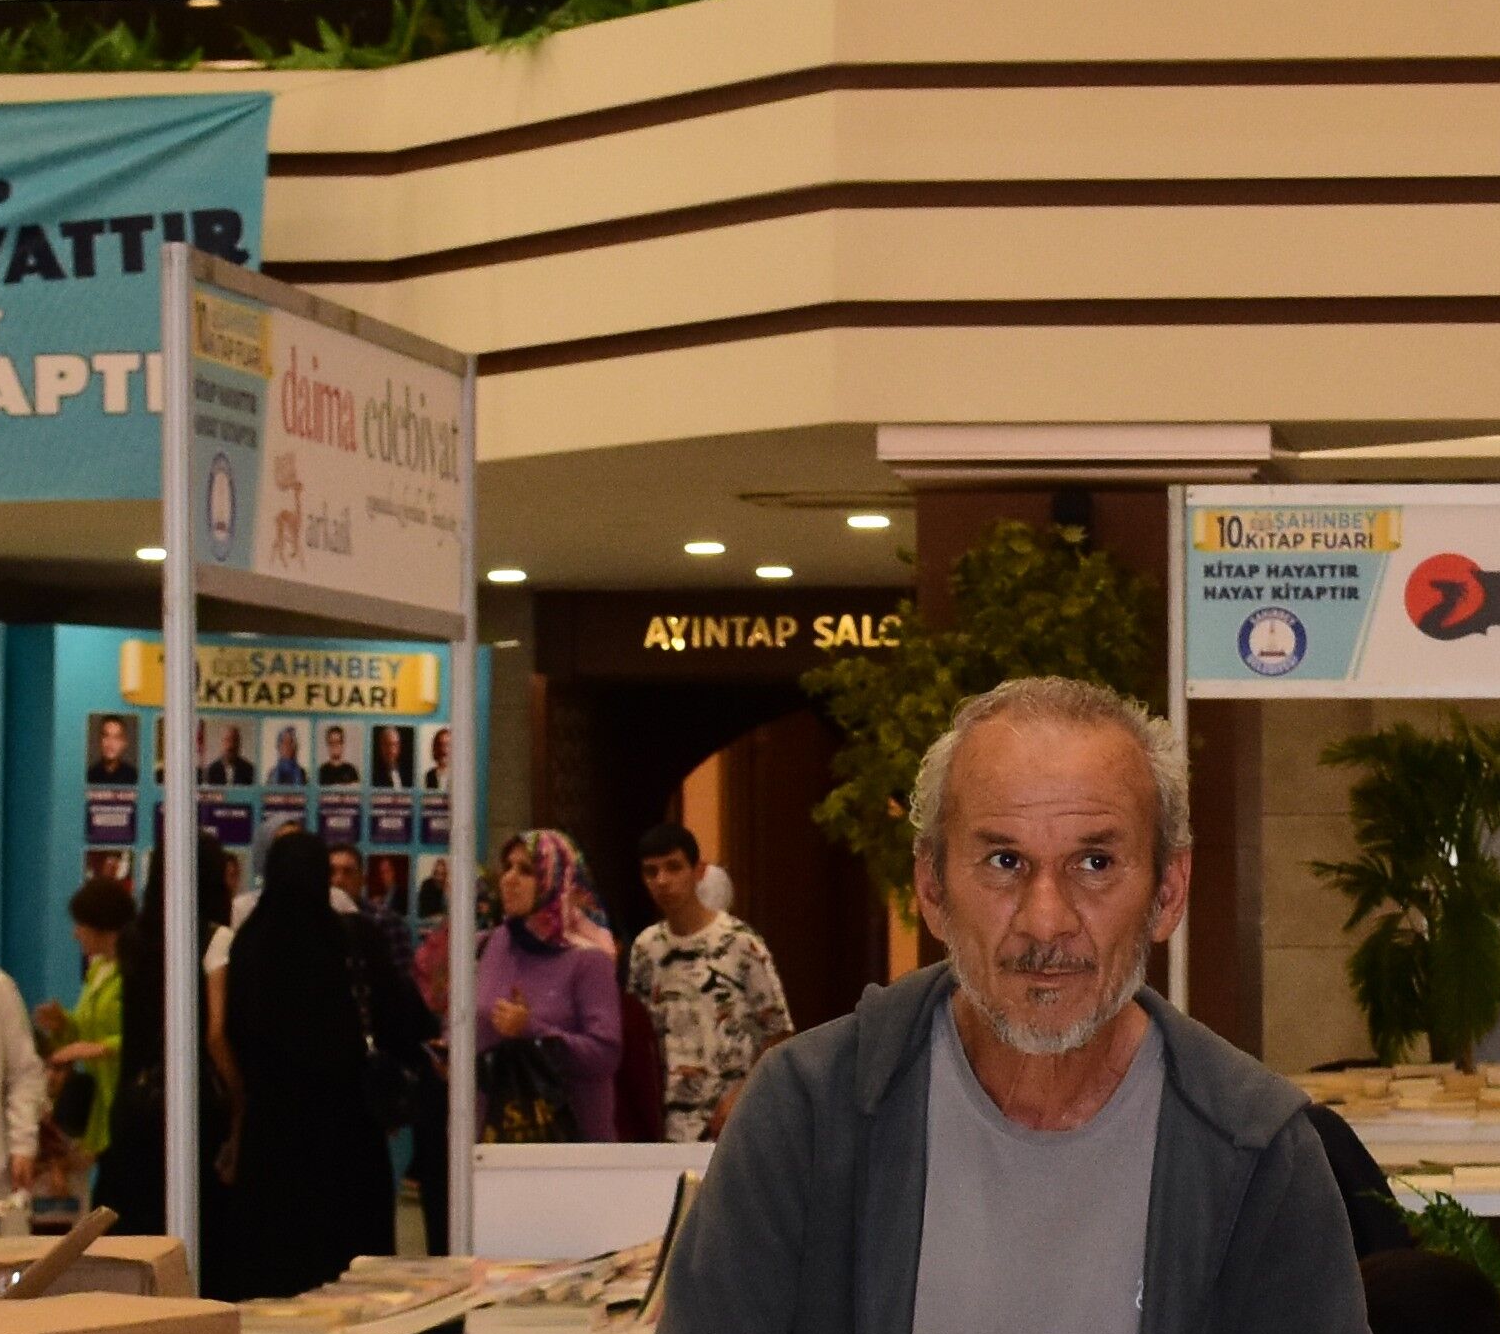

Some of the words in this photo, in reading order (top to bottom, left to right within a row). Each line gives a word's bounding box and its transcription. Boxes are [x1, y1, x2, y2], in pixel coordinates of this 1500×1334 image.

[1311, 532, 1374, 550] FUARI
[1266, 563, 1360, 579] HAYATTIR
[1203, 585, 1265, 601] HAYAT
[305, 683, 398, 710] FUARI
